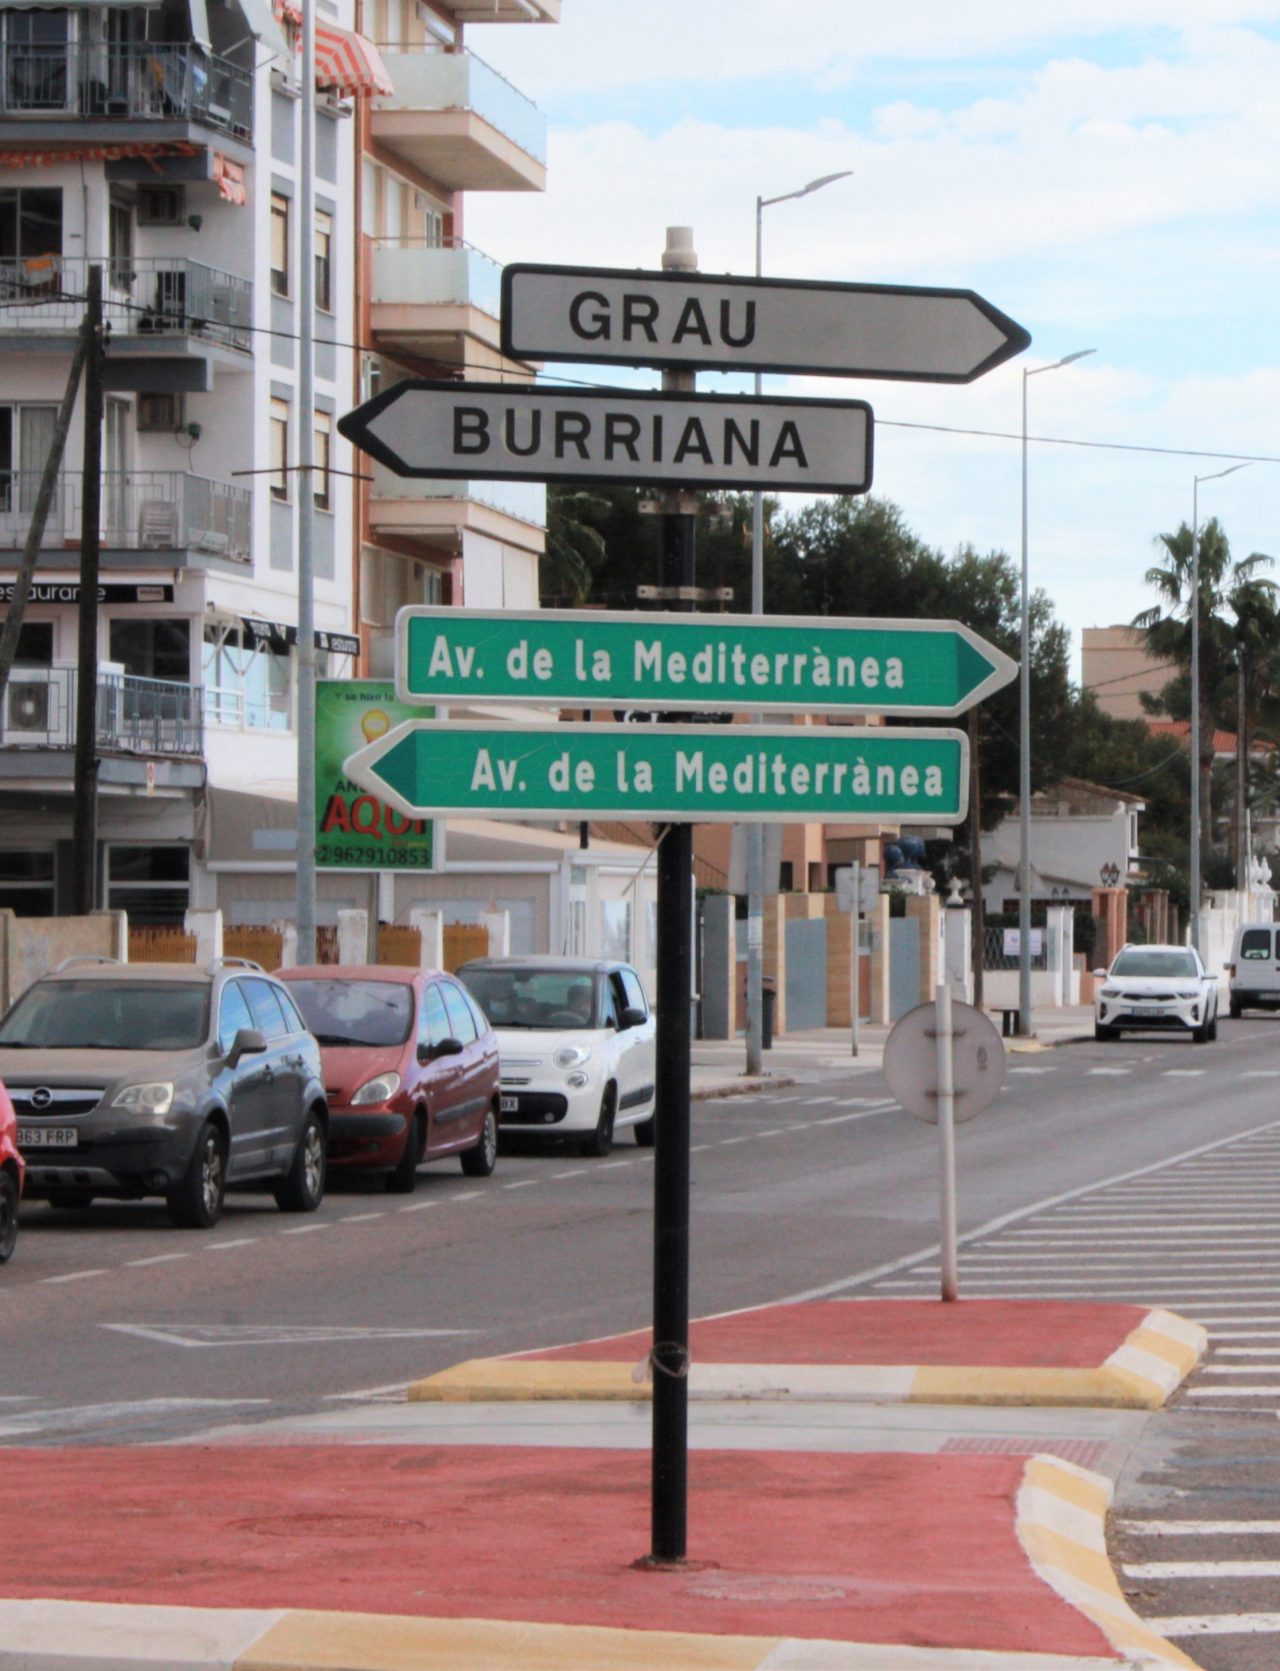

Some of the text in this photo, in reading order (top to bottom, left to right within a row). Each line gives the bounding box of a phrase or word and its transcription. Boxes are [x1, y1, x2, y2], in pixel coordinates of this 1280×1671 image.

[568, 290, 756, 349] GRAU
[452, 405, 809, 469] BURRIANA
[427, 635, 904, 689] Av. de la Mediterrànea
[470, 748, 943, 797] Av. de la Mediterrànea
[333, 846, 429, 865] 962910853
